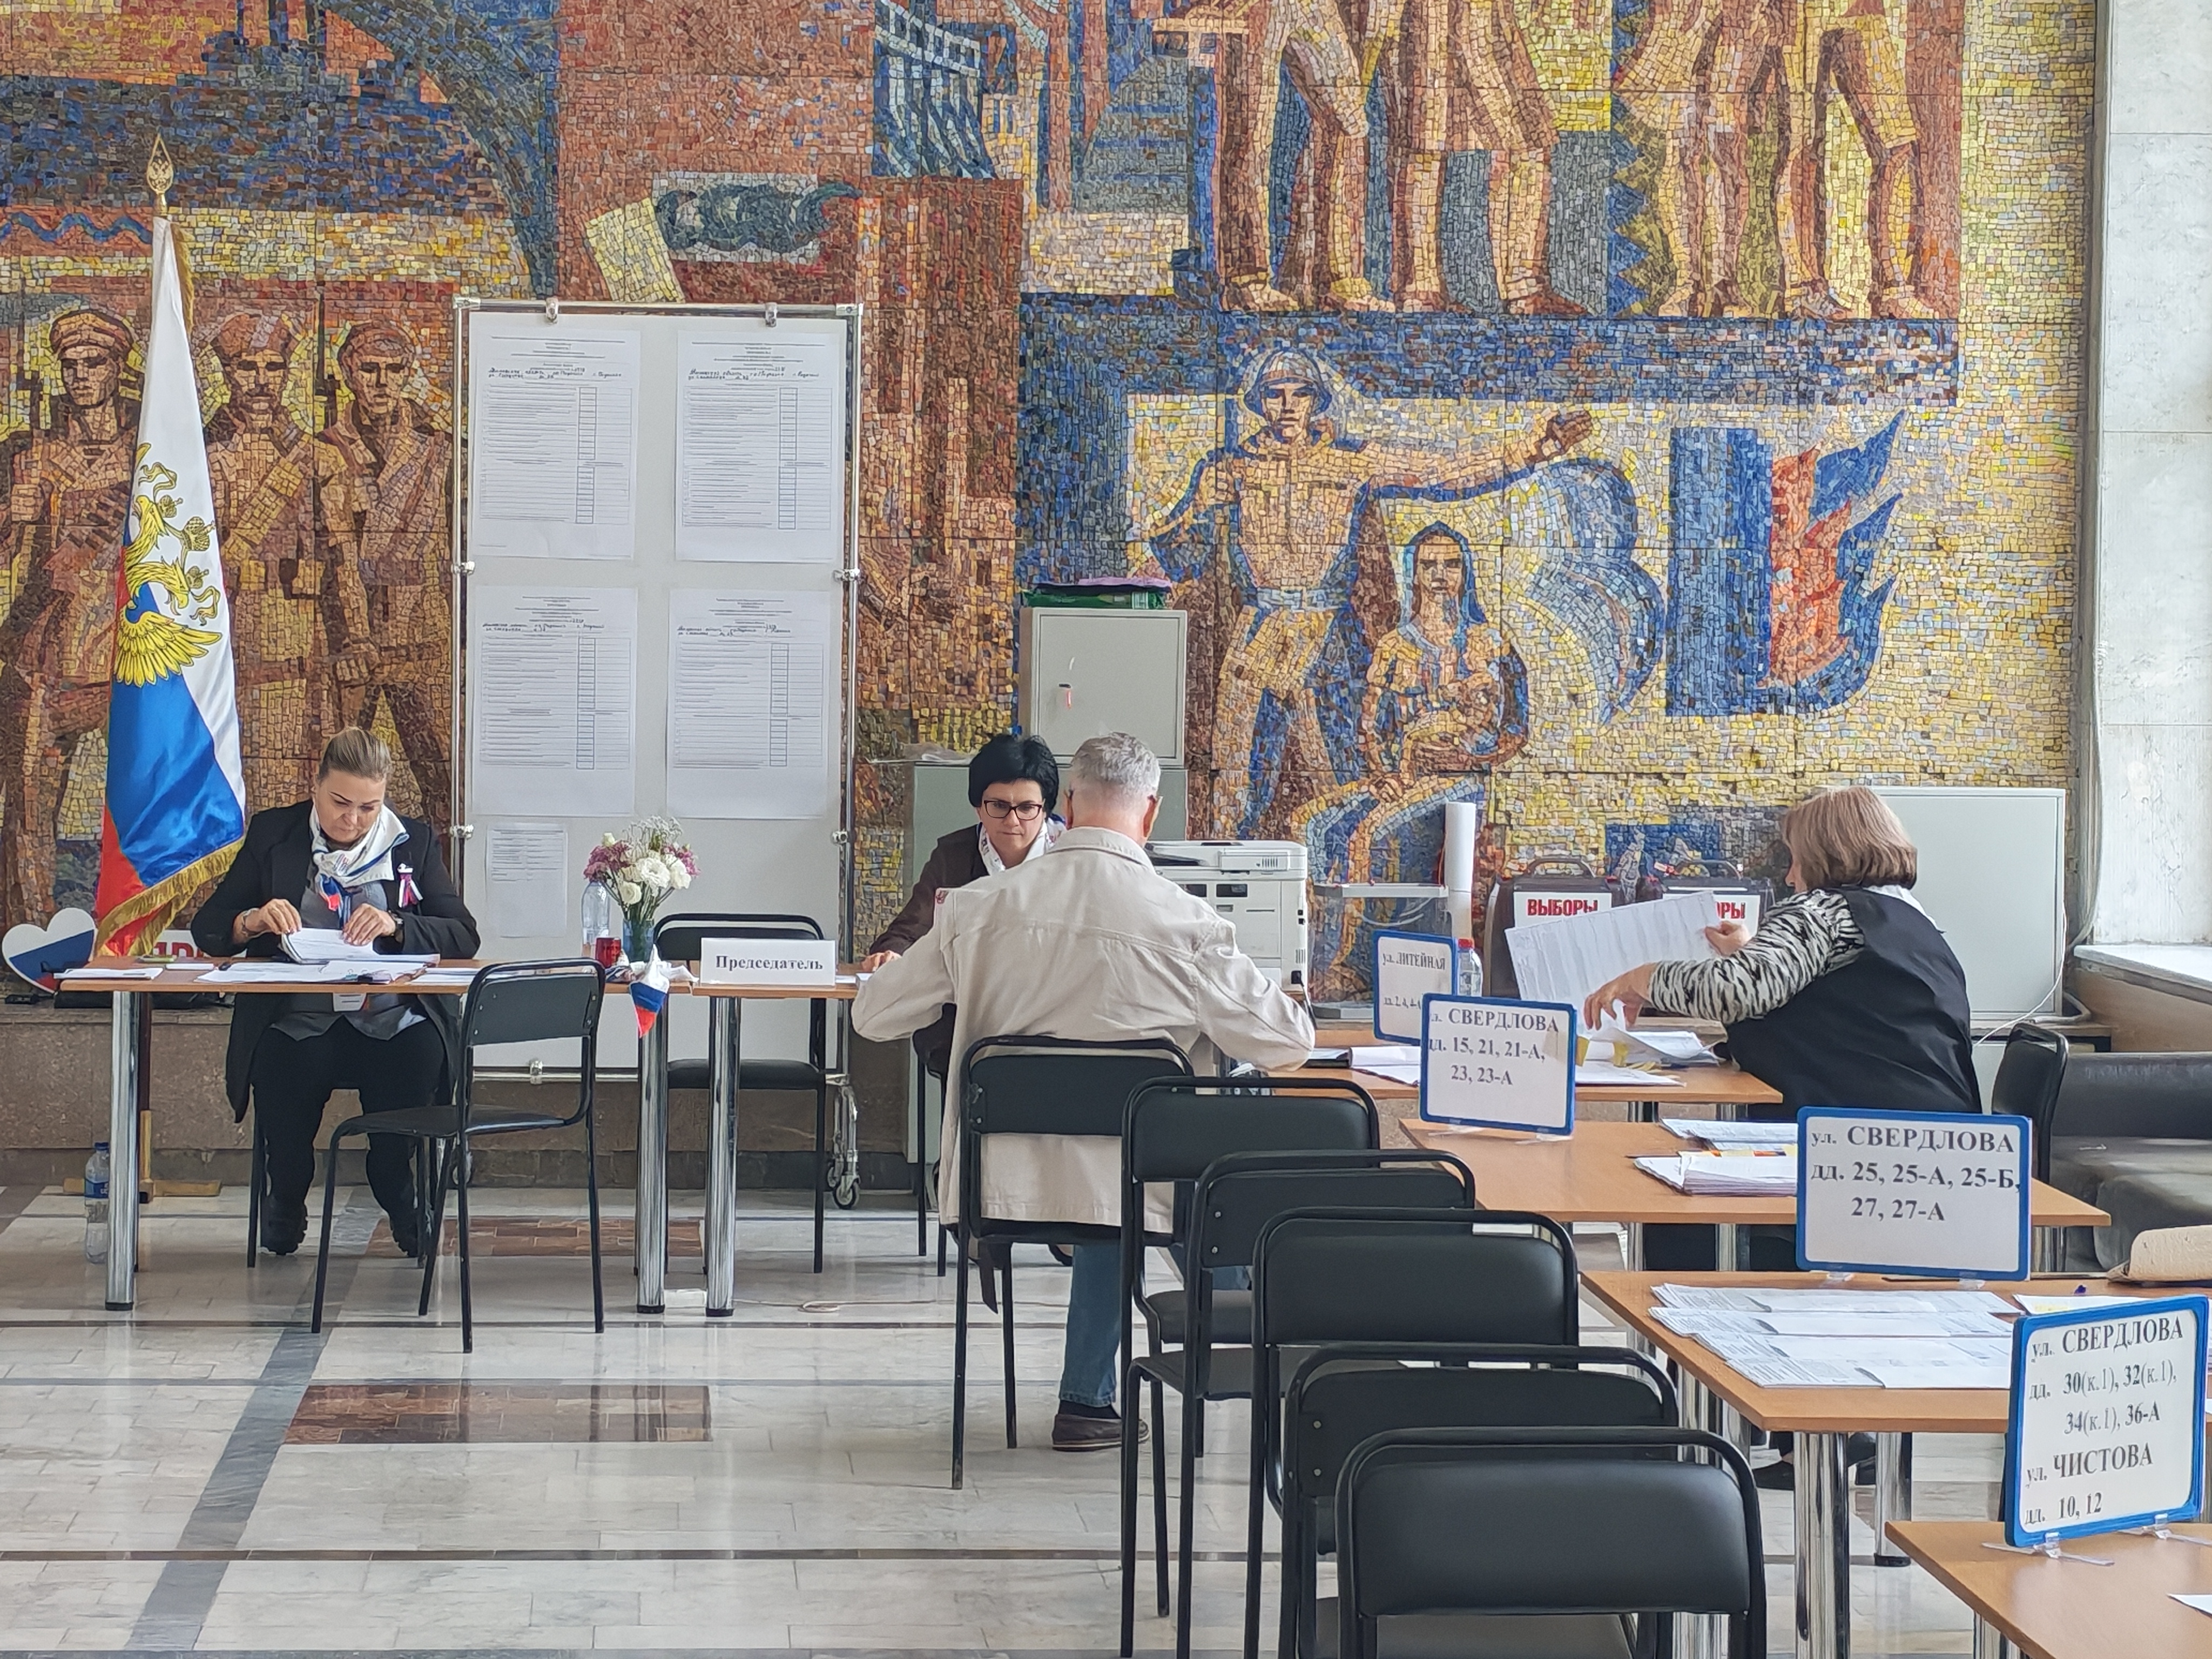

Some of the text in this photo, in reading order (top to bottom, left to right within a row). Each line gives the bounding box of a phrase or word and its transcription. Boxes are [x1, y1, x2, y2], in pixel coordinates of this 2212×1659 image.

[1527, 899, 1598, 916] ВЫБОРЫ
[1716, 901, 1745, 920] ОРЫ
[716, 955, 824, 972] Председатель
[1396, 952, 1445, 970] ЛИТЕЙНАЯ
[1430, 1008, 1559, 1033] л. СВЕРДЛОВА
[1453, 1037, 1474, 1056] 15,
[1478, 1038, 1500, 1058] 21,
[1505, 1041, 1546, 1063] 21-А,
[1451, 1064, 1513, 1085] 23, 23-А
[1811, 1125, 2015, 1153] ул. СВЕРДЛОВА
[1810, 1161, 2020, 1193] дд. 25, 25-А, 25-Б,
[1851, 1196, 1946, 1222] 27, 27-А
[2031, 1316, 2183, 1363] ул. СВЕРДЛОВА
[2028, 1383, 2051, 1401] дд.
[2125, 1400, 2161, 1427] 36-А
[2025, 1441, 2154, 1489] ул. ЧИСТОВА
[2024, 1492, 2102, 1526] дд. 10, 12
